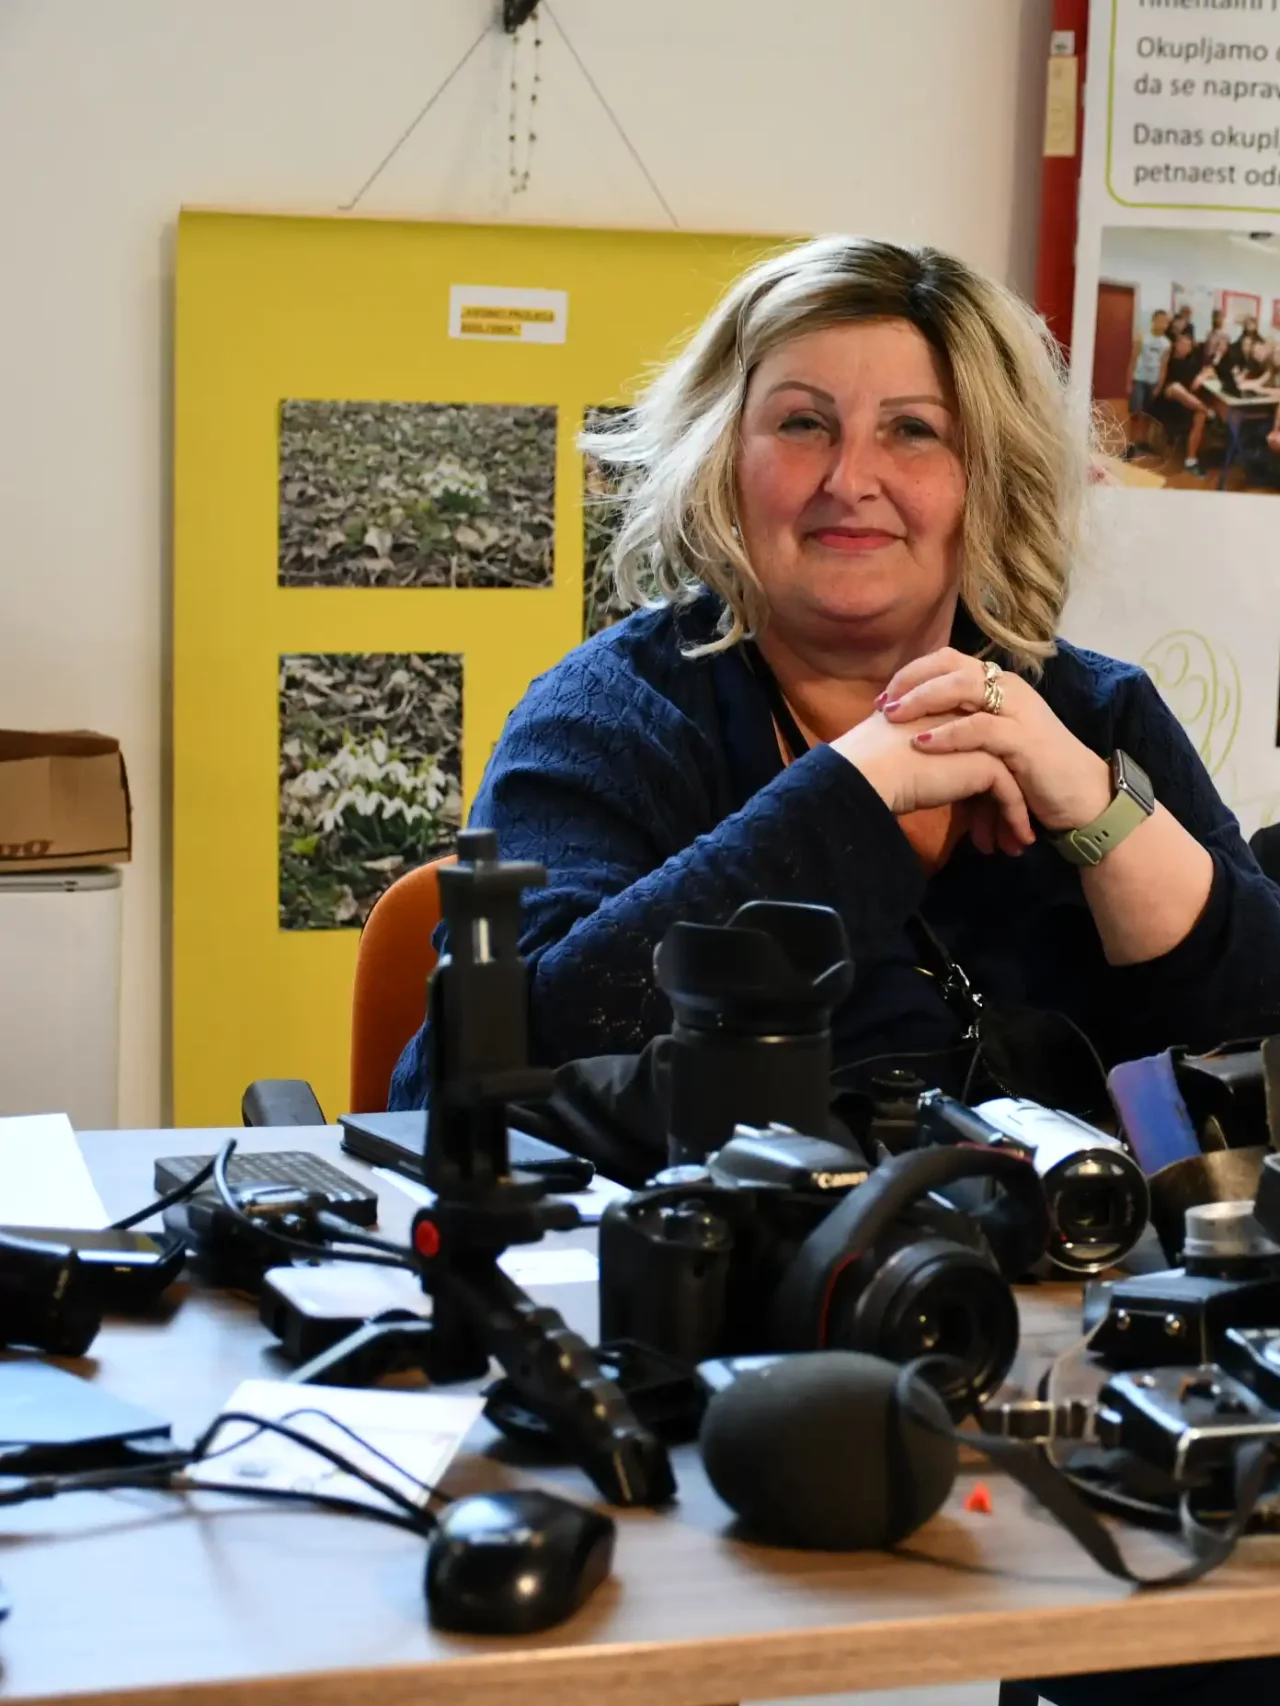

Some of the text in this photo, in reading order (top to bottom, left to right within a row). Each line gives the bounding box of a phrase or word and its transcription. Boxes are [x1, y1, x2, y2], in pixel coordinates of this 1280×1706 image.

[1136, 36, 1268, 64] Okupljamo
[1134, 73, 1162, 96] da
[1169, 78, 1196, 97] se
[1133, 122, 1204, 147] Danas
[1134, 163, 1236, 186] petnaest
